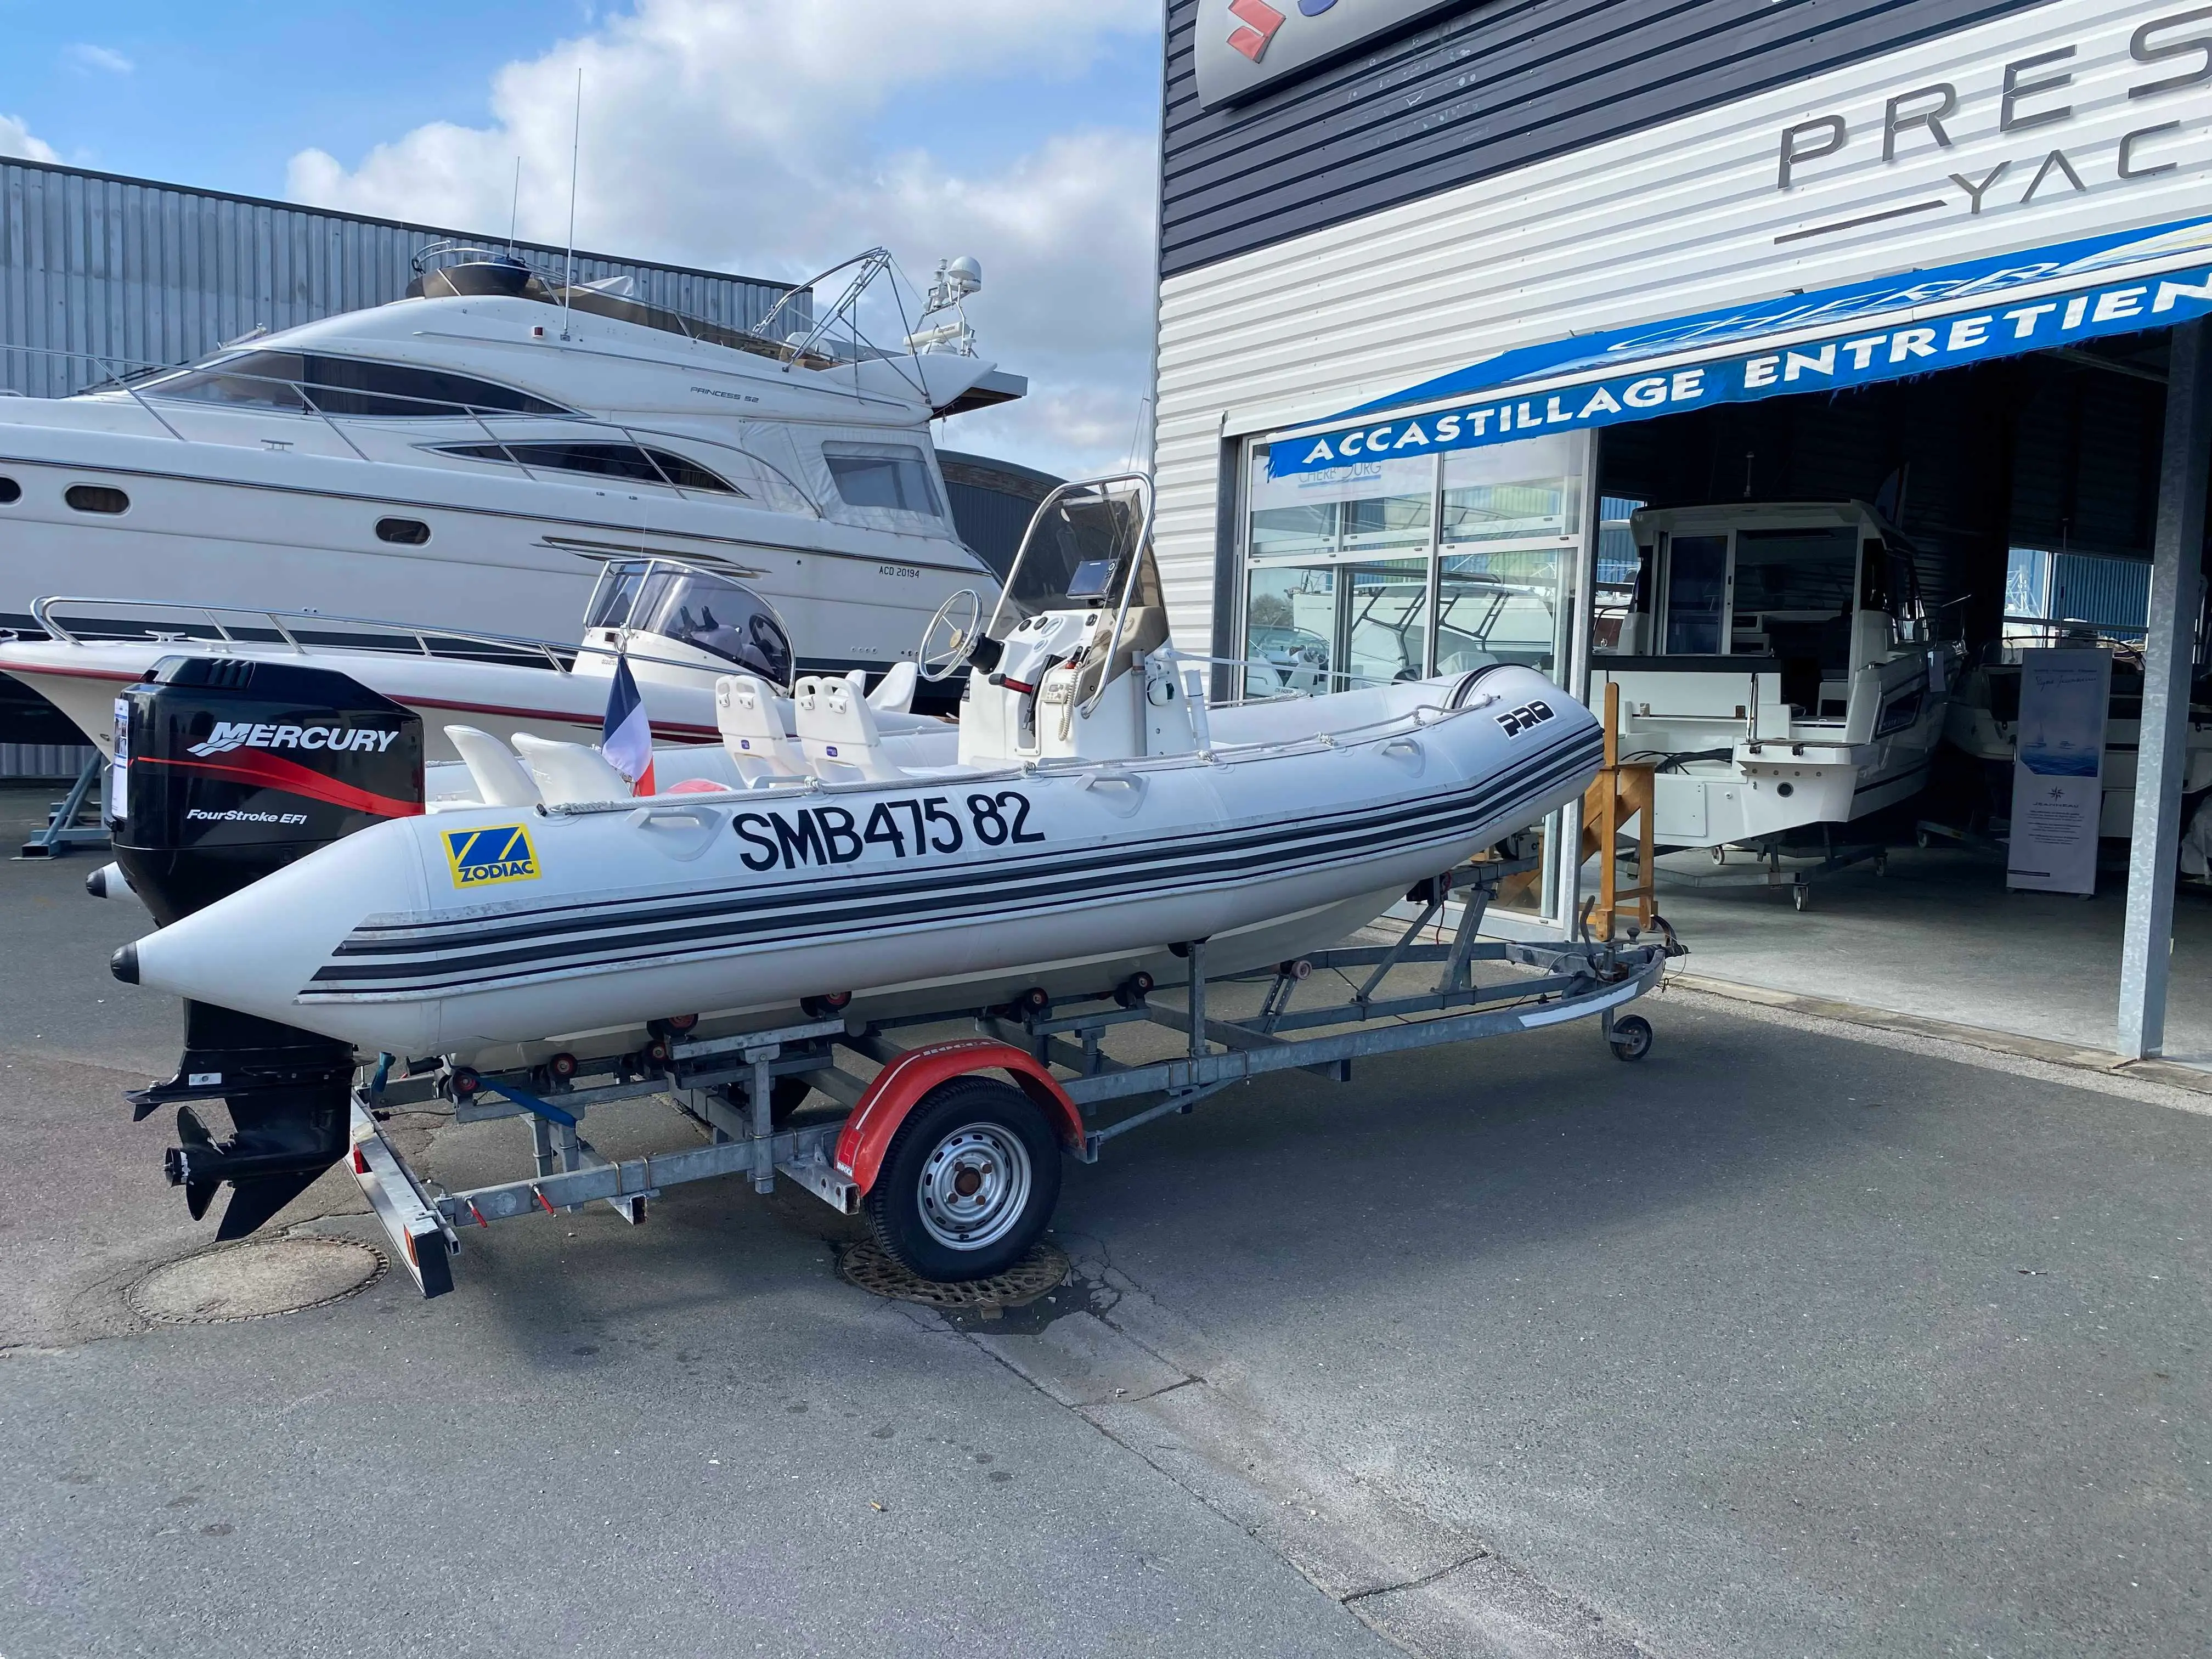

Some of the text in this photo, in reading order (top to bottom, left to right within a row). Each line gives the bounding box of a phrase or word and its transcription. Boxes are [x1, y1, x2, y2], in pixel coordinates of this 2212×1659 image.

[1302, 273, 2212, 464] ACCASTILLAGE ENTRETIEN
[691, 387, 741, 400] PRINCESS
[879, 566, 919, 578] ACD 20194
[1494, 700, 1555, 739] PRO
[205, 721, 399, 753] MERCURY
[187, 809, 307, 825] FourStroke EFI
[458, 860, 534, 883] ZODIAC
